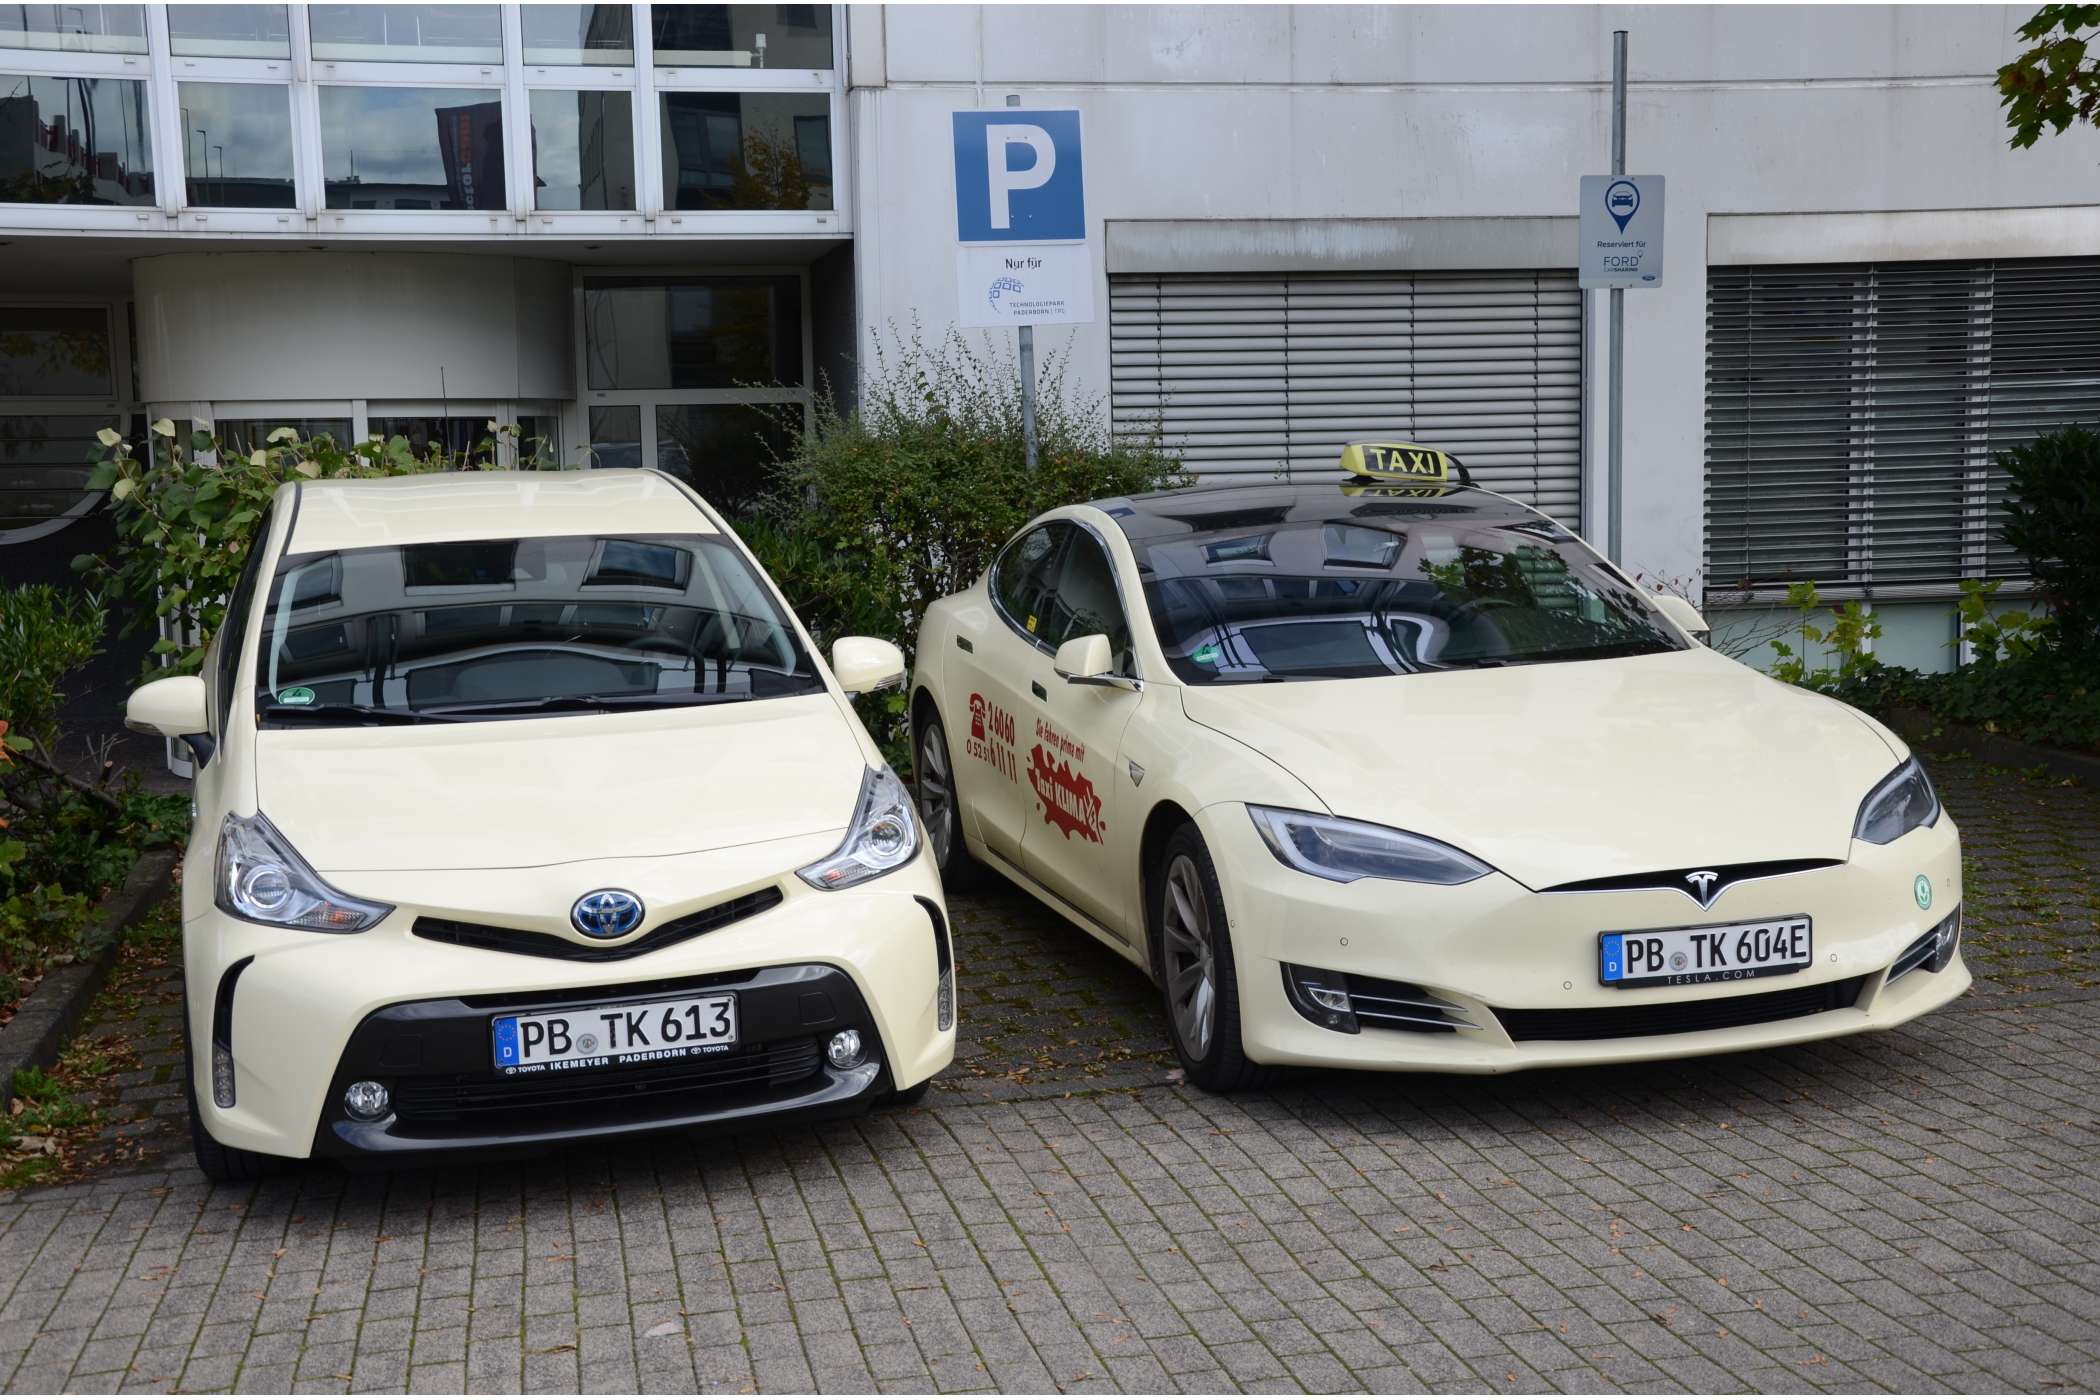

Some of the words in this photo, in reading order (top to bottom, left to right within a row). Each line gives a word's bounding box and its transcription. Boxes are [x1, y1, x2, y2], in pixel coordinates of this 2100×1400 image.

[986, 124, 1056, 229] P
[1005, 258, 1024, 270] Nur
[1027, 257, 1042, 269] für
[1603, 256, 1639, 267] FORD
[1369, 448, 1435, 474] TAXI
[1035, 768, 1054, 802] Taxi
[1626, 939, 1664, 974] PB
[1690, 932, 1727, 968] TK
[1736, 924, 1807, 964] 604E
[1608, 961, 1617, 972] D
[1667, 969, 1755, 985] TESLA.COM
[521, 1019, 572, 1058] PB
[600, 1010, 650, 1048] TK
[660, 1002, 731, 1043] 613
[503, 1046, 513, 1058] D
[517, 1065, 546, 1073] TOYOTA
[550, 1057, 609, 1070] IKEMEYER
[619, 1048, 687, 1064] PADERBORN
[702, 1045, 729, 1053] TOYOTA
